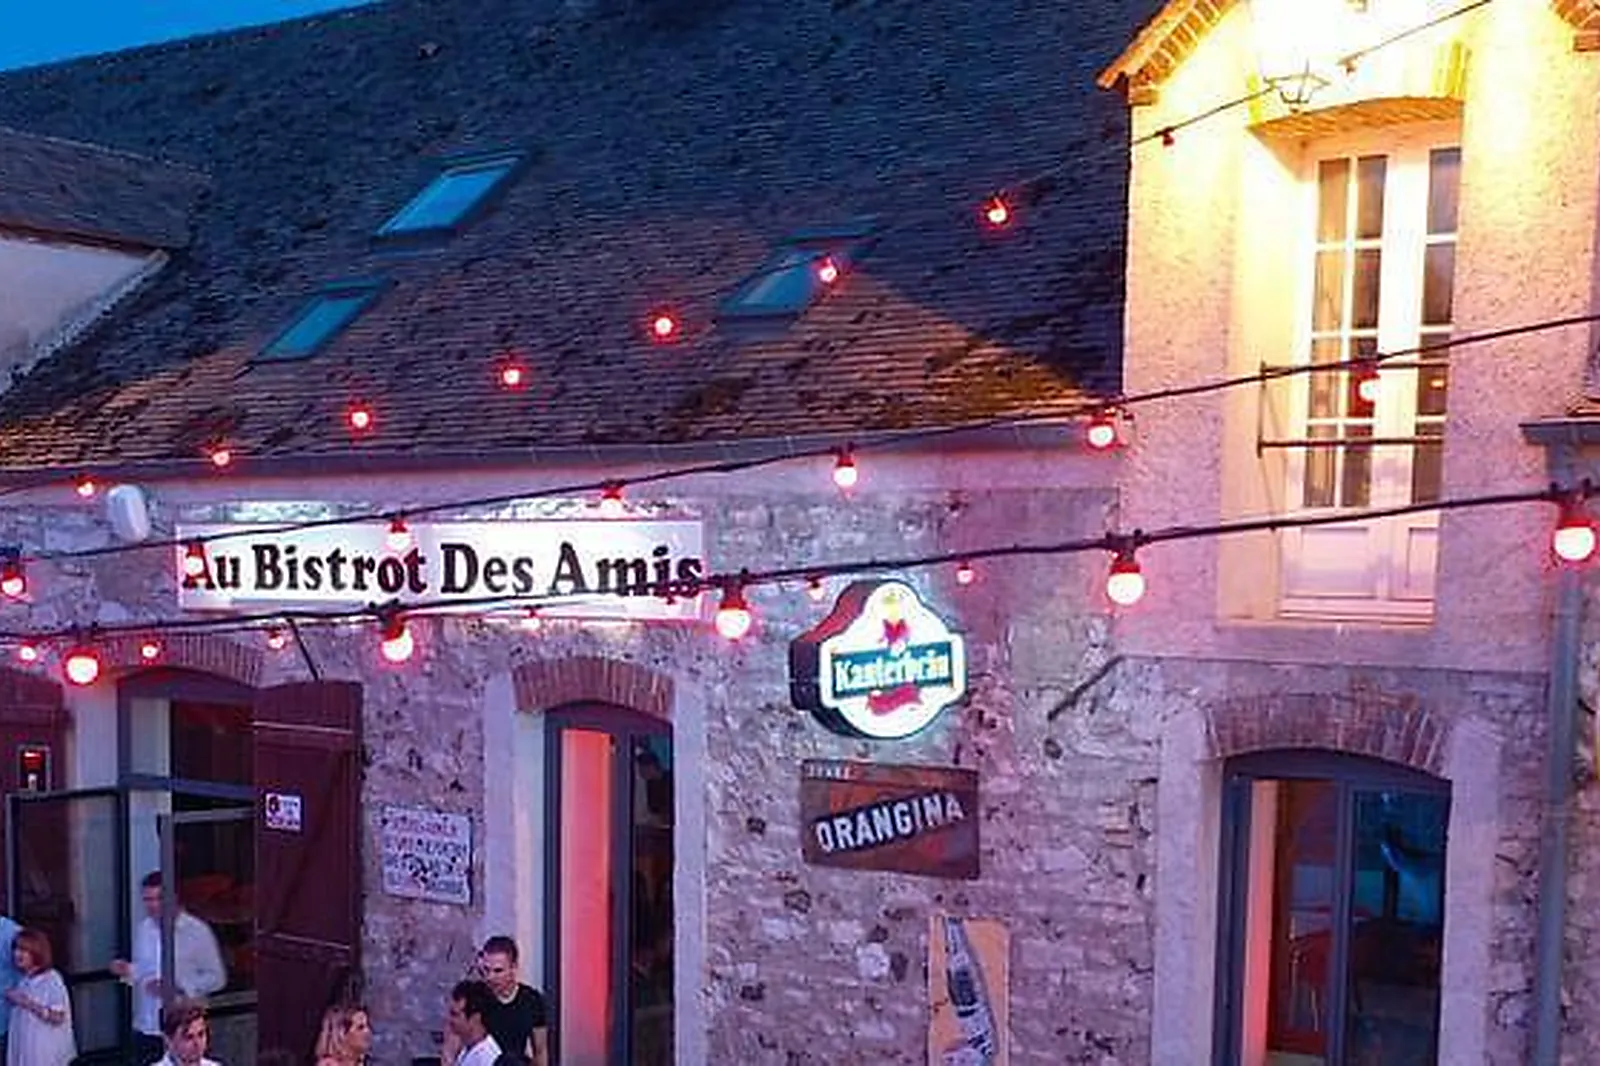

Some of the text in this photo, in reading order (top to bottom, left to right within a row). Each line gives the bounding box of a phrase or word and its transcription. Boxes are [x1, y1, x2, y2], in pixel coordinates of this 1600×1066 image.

[183, 541, 702, 597] Au Bistrot Des Amis
[816, 793, 964, 852] ORANGINA
